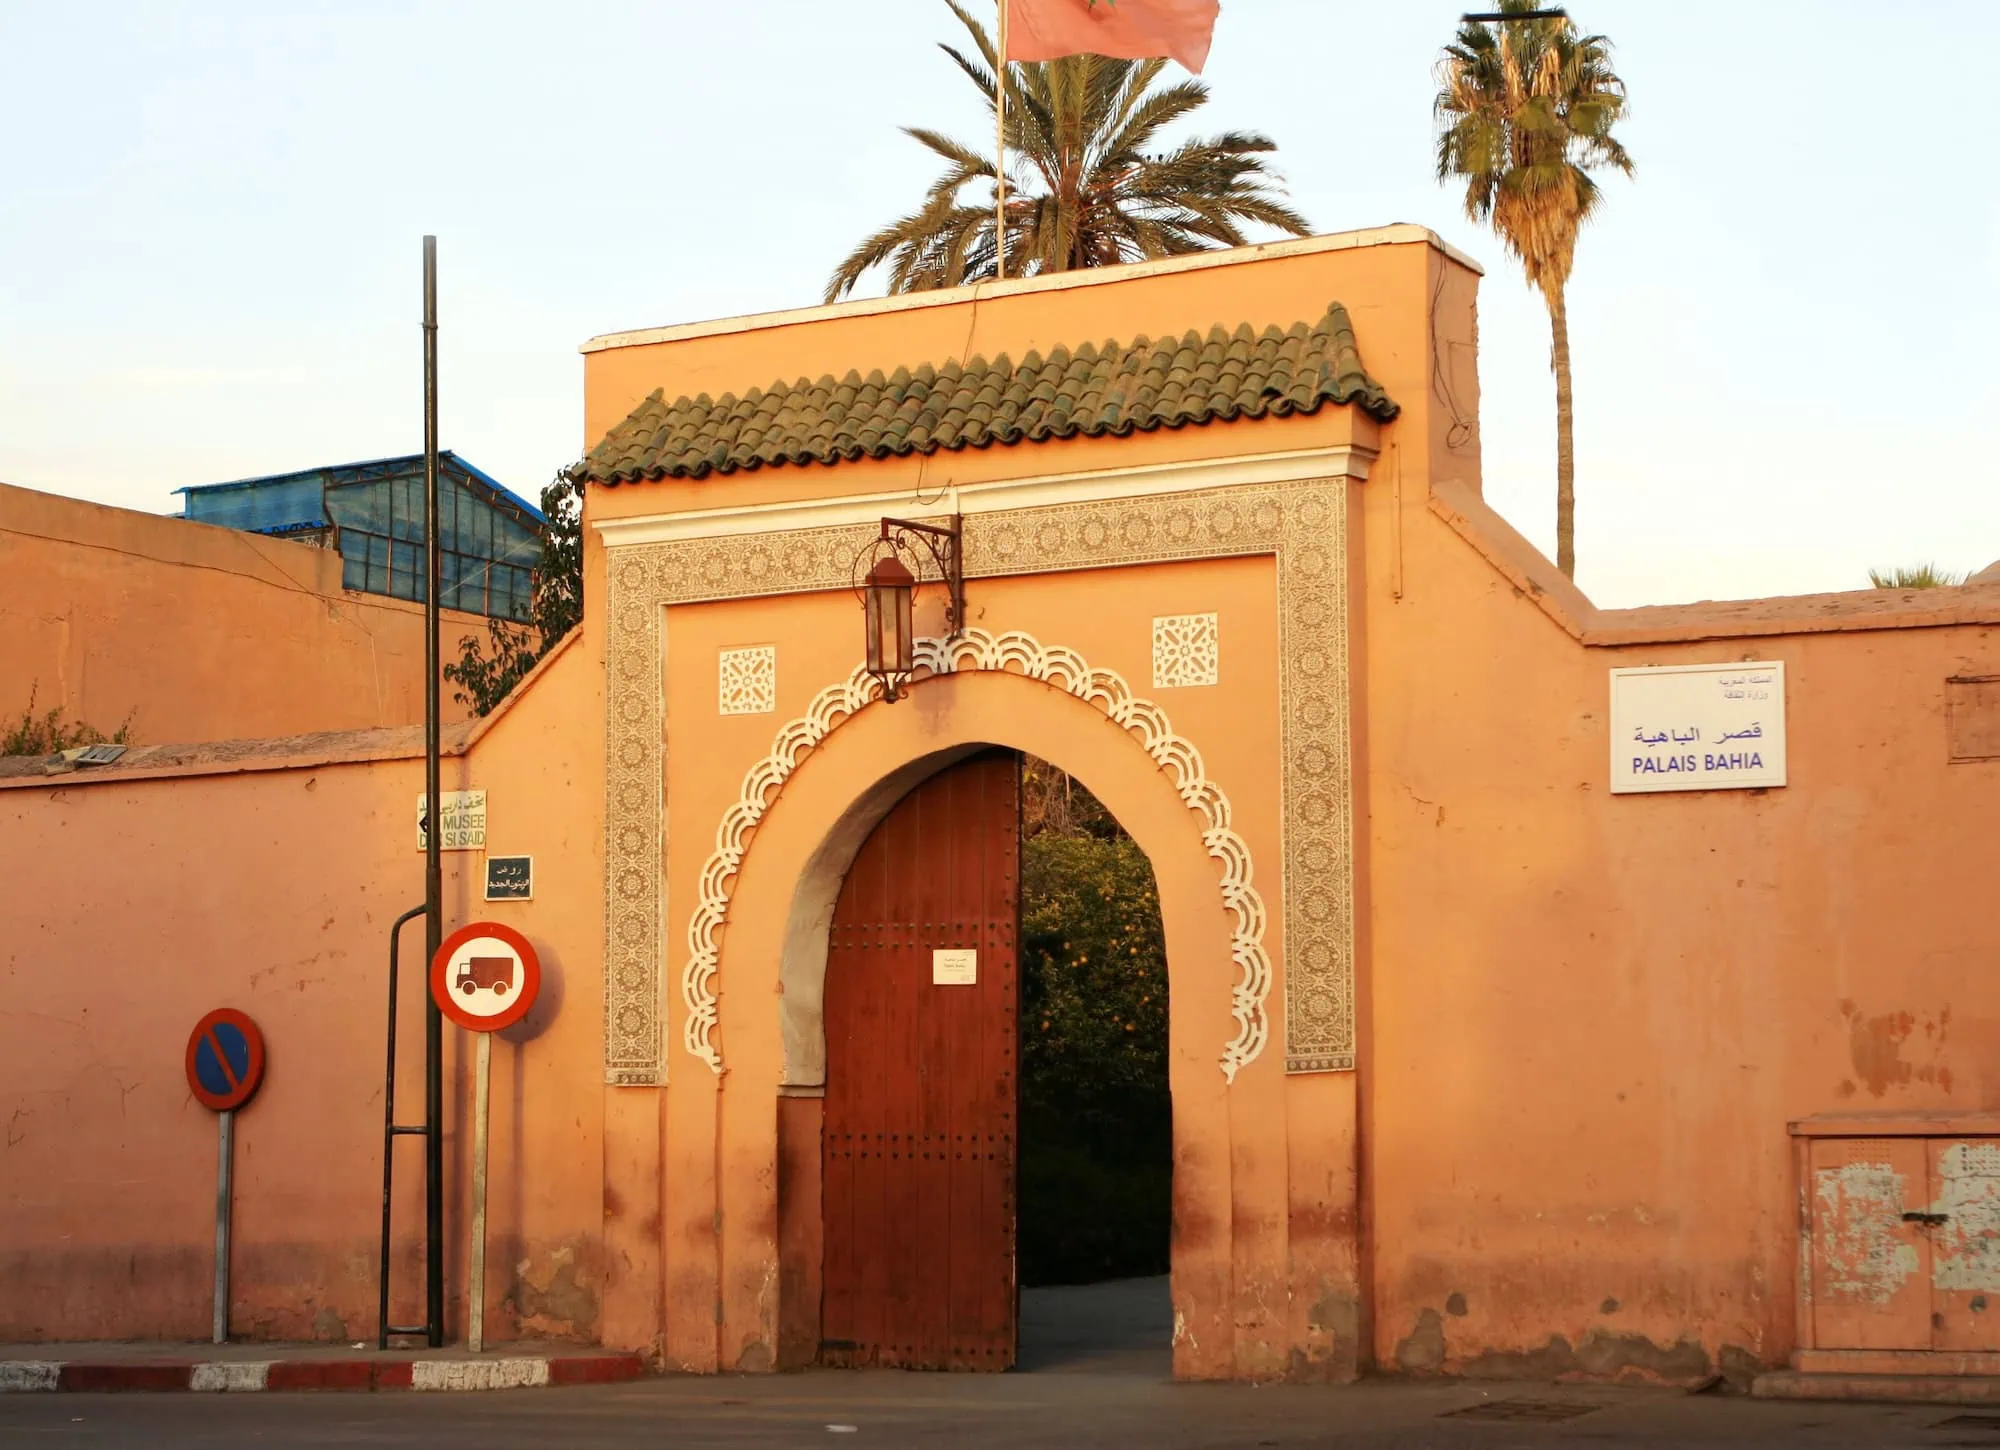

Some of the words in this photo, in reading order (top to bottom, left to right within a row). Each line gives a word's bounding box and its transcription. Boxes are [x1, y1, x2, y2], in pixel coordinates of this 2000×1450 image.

[1634, 726, 1700, 748] الباهية
[1712, 721, 1763, 745] قصر
[1633, 754, 1697, 774] PALAIS
[1704, 752, 1764, 771] BAHIA
[443, 814, 485, 831] MUSEE
[445, 832, 456, 847] SI
[459, 831, 485, 846] SAID
